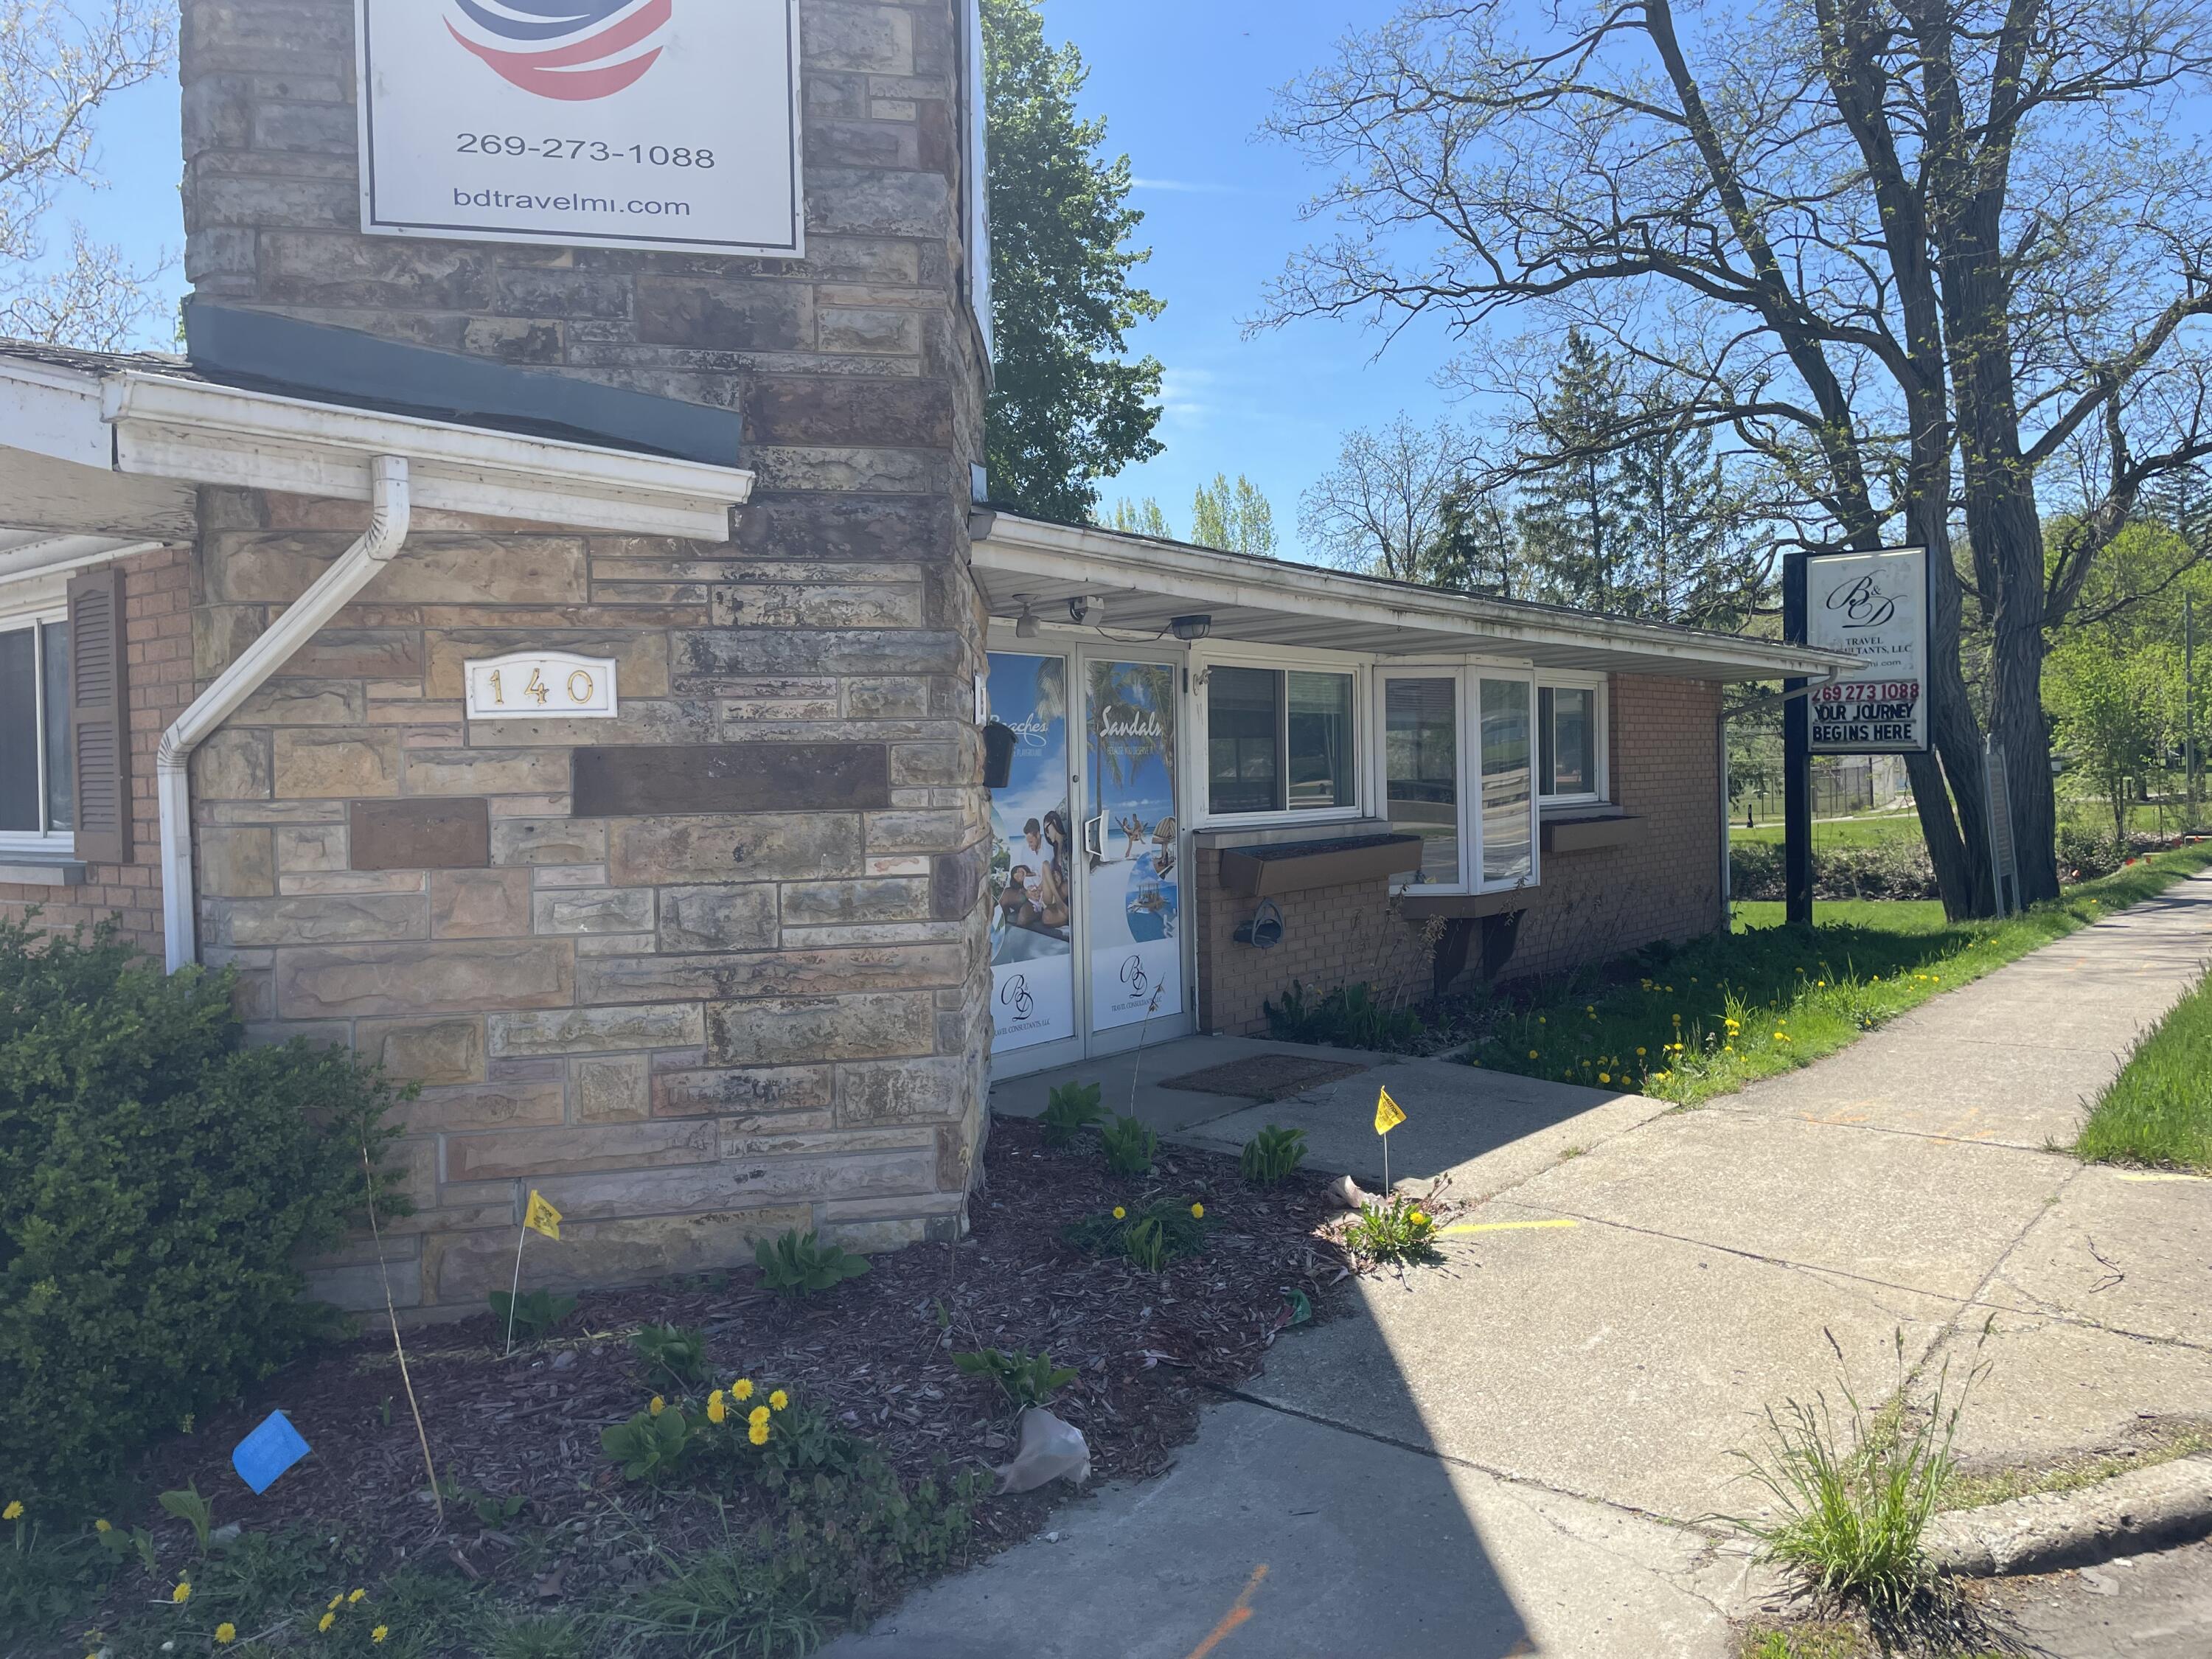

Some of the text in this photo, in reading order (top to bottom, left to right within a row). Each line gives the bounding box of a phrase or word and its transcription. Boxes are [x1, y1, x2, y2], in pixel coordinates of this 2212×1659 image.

[456, 133, 715, 169] 269-273-1088
[453, 188, 690, 215] bdtravelmi.com
[1844, 644, 1912, 654] ULTANTS, LLC
[1846, 636, 1883, 645] TRAVEL
[490, 667, 594, 704] 140
[1812, 683, 1919, 702] 269 273 1088
[1099, 705, 1162, 737] Sandals
[1815, 703, 1914, 720] YOUR JOURNEY
[990, 713, 1048, 747] aches
[1813, 723, 1912, 741] BEGINS HERE
[995, 1028, 1007, 1036] AVEL
